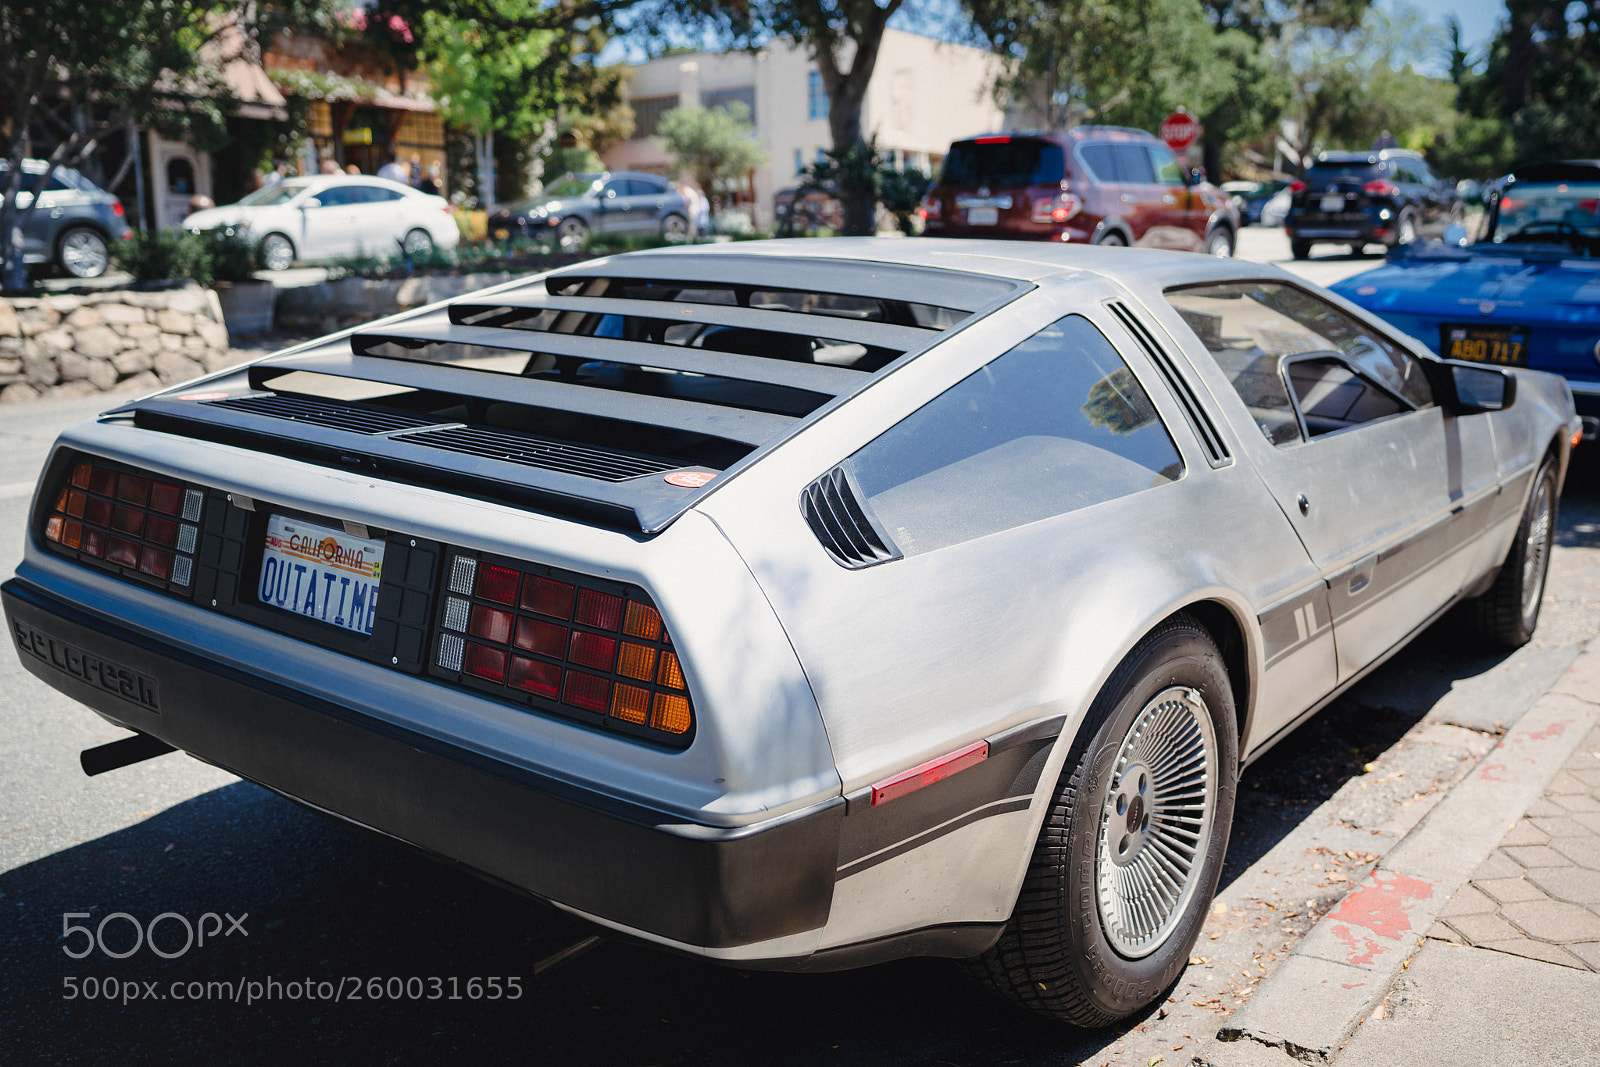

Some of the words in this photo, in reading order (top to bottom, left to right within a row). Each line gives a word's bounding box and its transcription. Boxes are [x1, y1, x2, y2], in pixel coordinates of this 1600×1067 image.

[1161, 124, 1193, 140] STOP
[1491, 341, 1522, 363] 717
[289, 534, 364, 569] CALIFORNIA
[261, 556, 379, 634] OUTATIME
